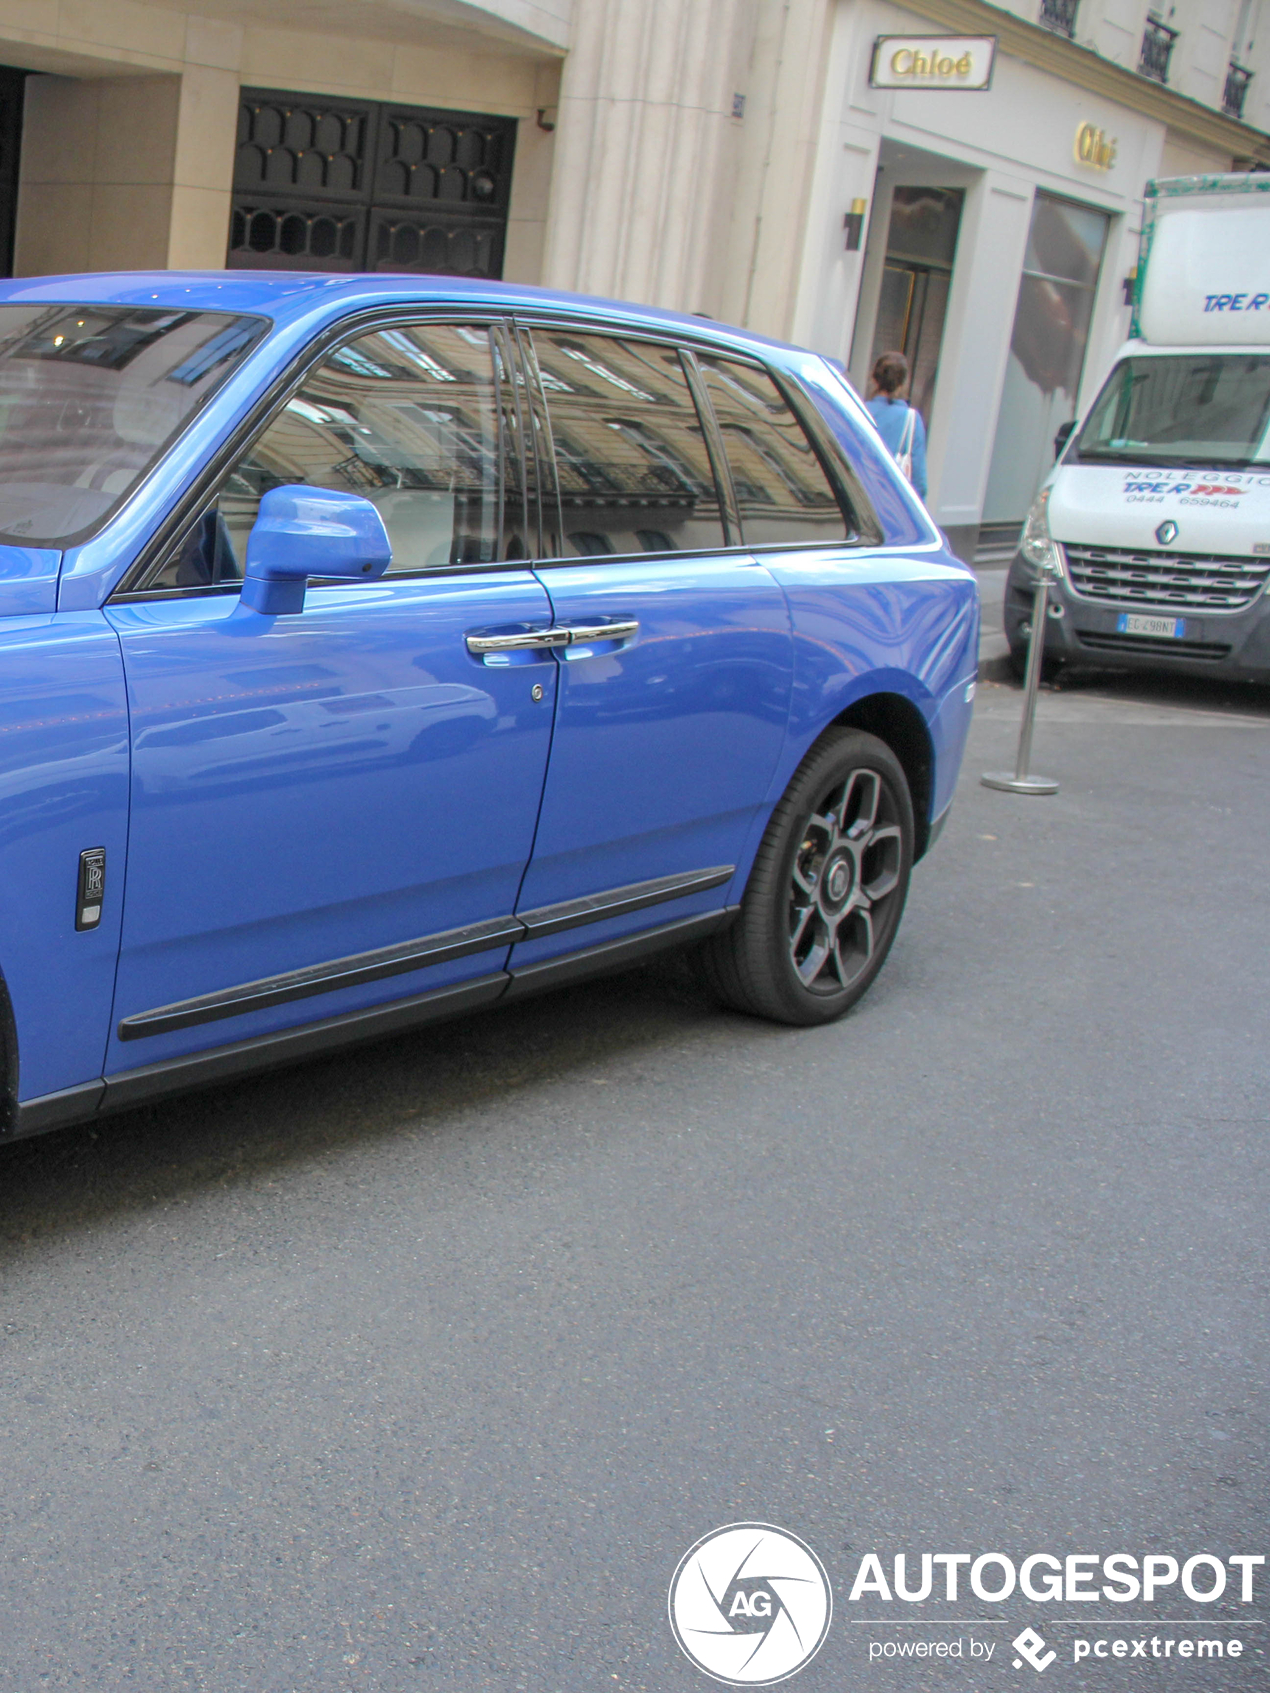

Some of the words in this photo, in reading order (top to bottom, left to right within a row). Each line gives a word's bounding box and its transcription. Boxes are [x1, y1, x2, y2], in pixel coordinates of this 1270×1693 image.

[890, 47, 973, 76] Chloé
[1126, 494, 1165, 503] 0444
[1180, 496, 1240, 509] 659464
